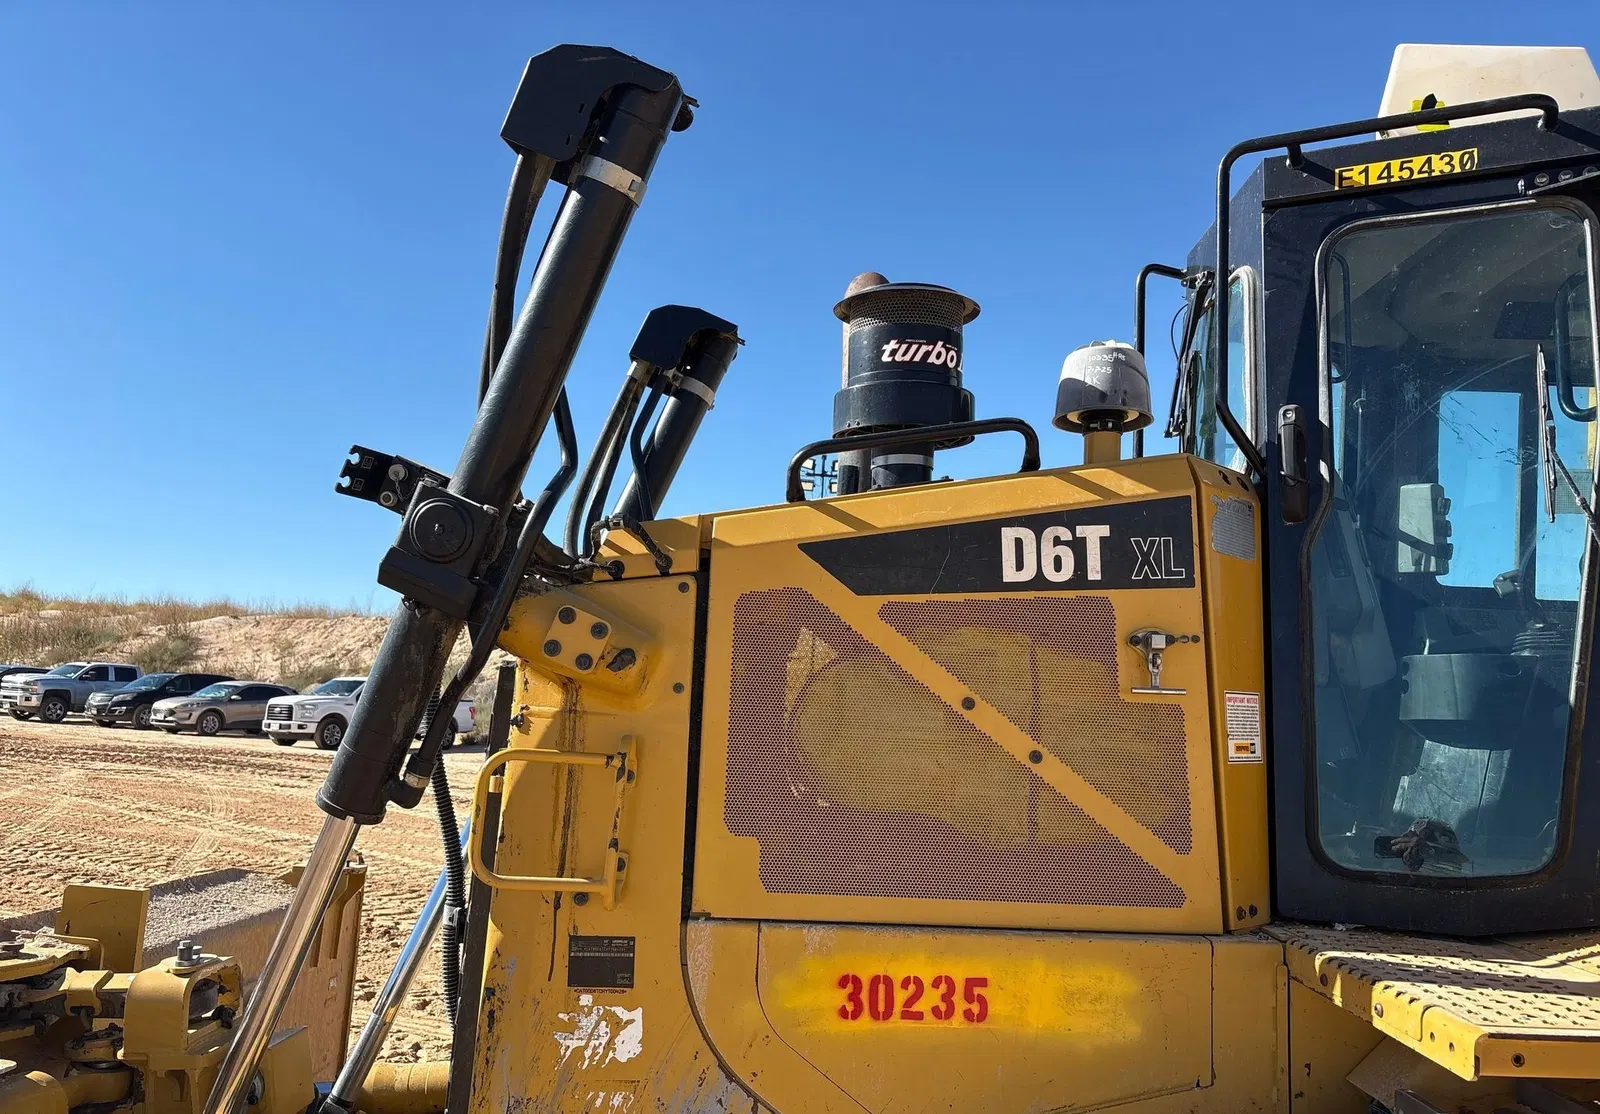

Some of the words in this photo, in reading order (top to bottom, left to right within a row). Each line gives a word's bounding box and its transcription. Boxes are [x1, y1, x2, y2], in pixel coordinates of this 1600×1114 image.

[1338, 150, 1476, 188] E145430
[881, 339, 957, 368] turbo
[1001, 524, 1110, 583] D6T
[1130, 537, 1186, 580] XL
[838, 973, 988, 1023] 30235
